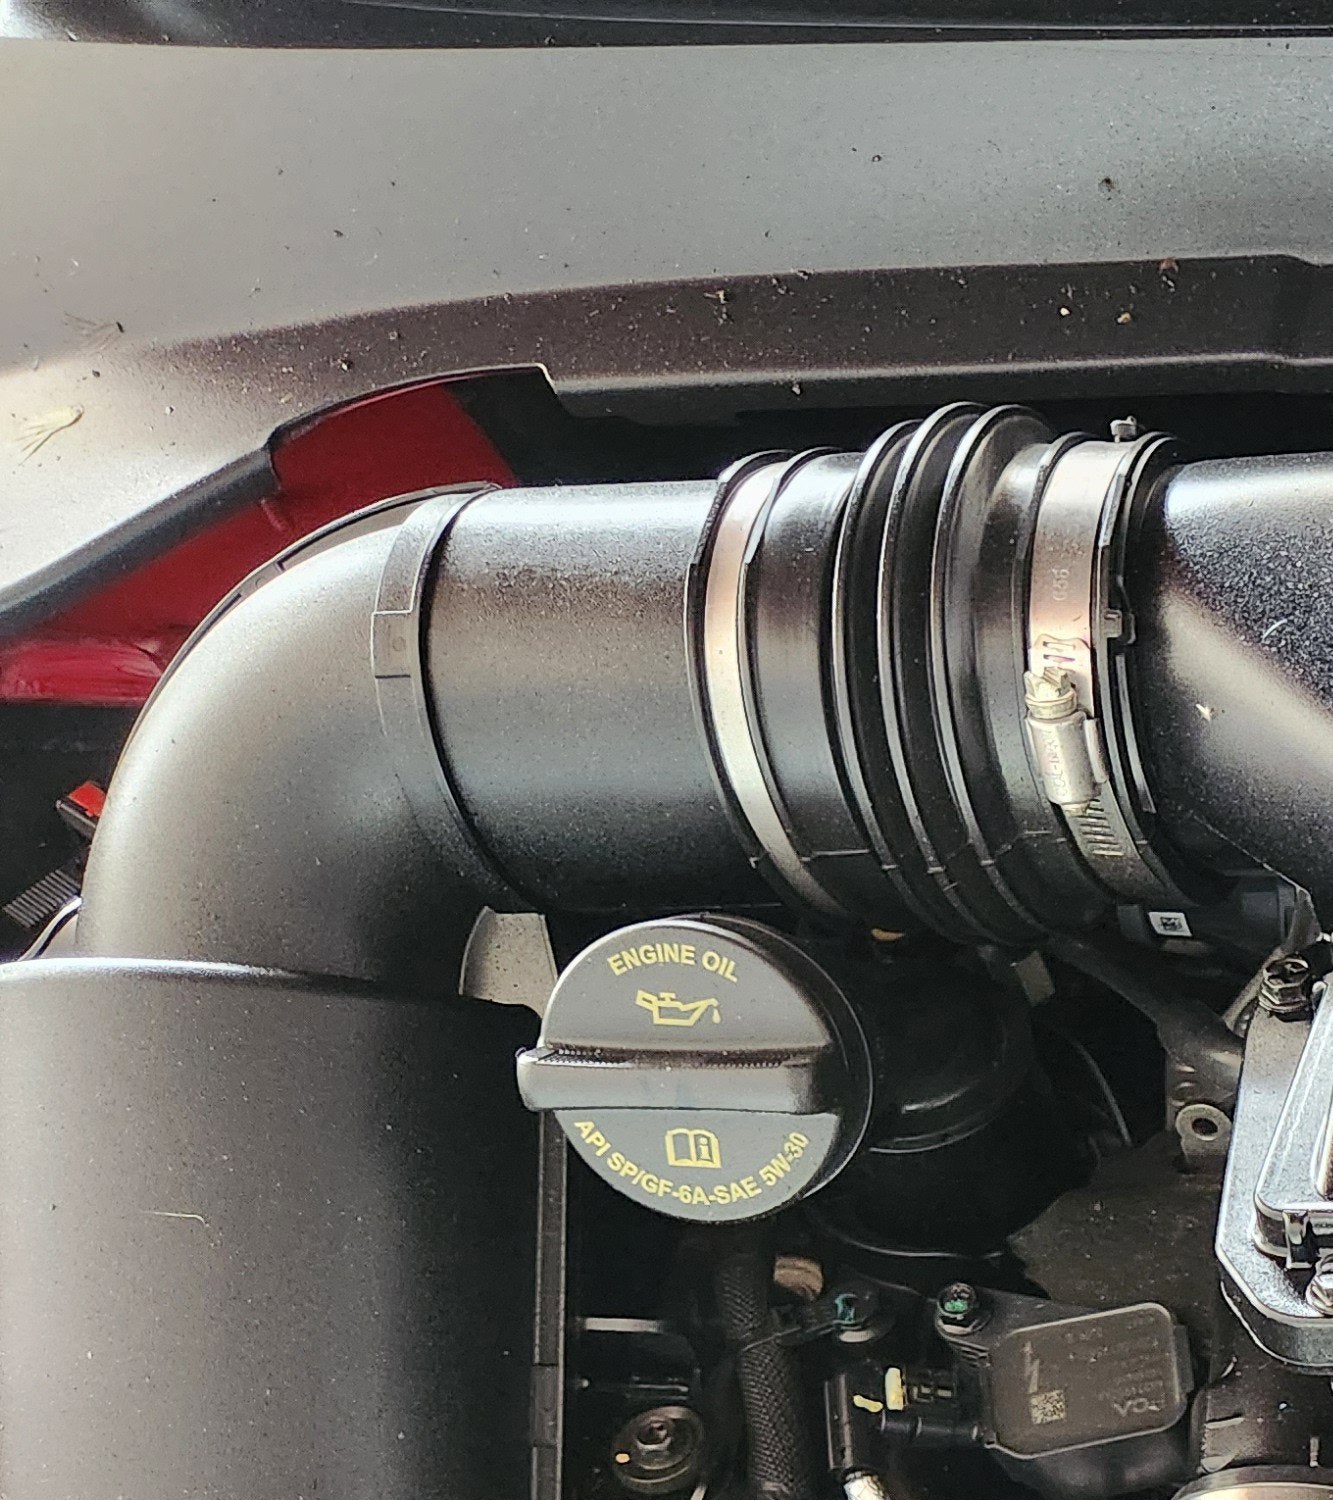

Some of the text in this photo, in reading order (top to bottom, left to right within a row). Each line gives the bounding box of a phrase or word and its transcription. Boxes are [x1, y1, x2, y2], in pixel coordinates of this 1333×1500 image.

[607, 943, 739, 983] ENGINE OIL
[574, 1120, 611, 1156] API
[758, 1131, 810, 1187] 5W-30
